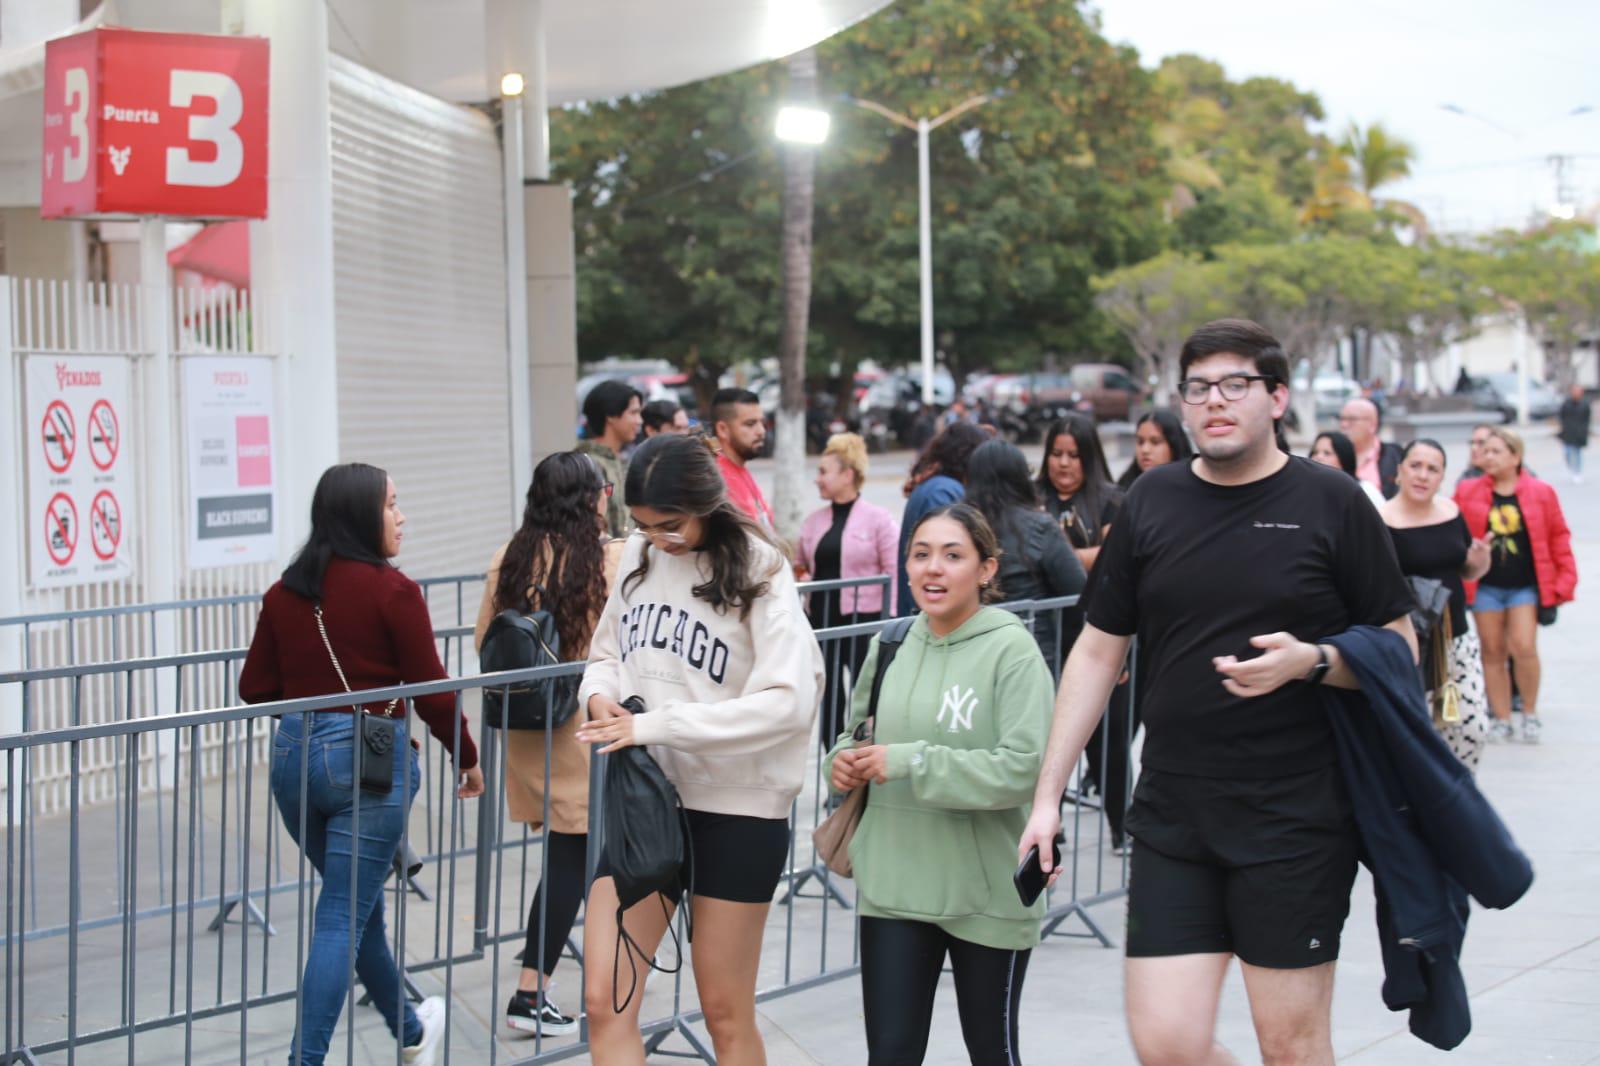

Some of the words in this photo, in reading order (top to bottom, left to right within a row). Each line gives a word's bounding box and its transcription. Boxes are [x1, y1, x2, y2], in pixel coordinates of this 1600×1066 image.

[63, 67, 90, 183] 3
[104, 104, 160, 124] Puerta
[166, 69, 244, 188] 3
[620, 603, 729, 684] CHICAGO
[936, 684, 979, 731] NY
